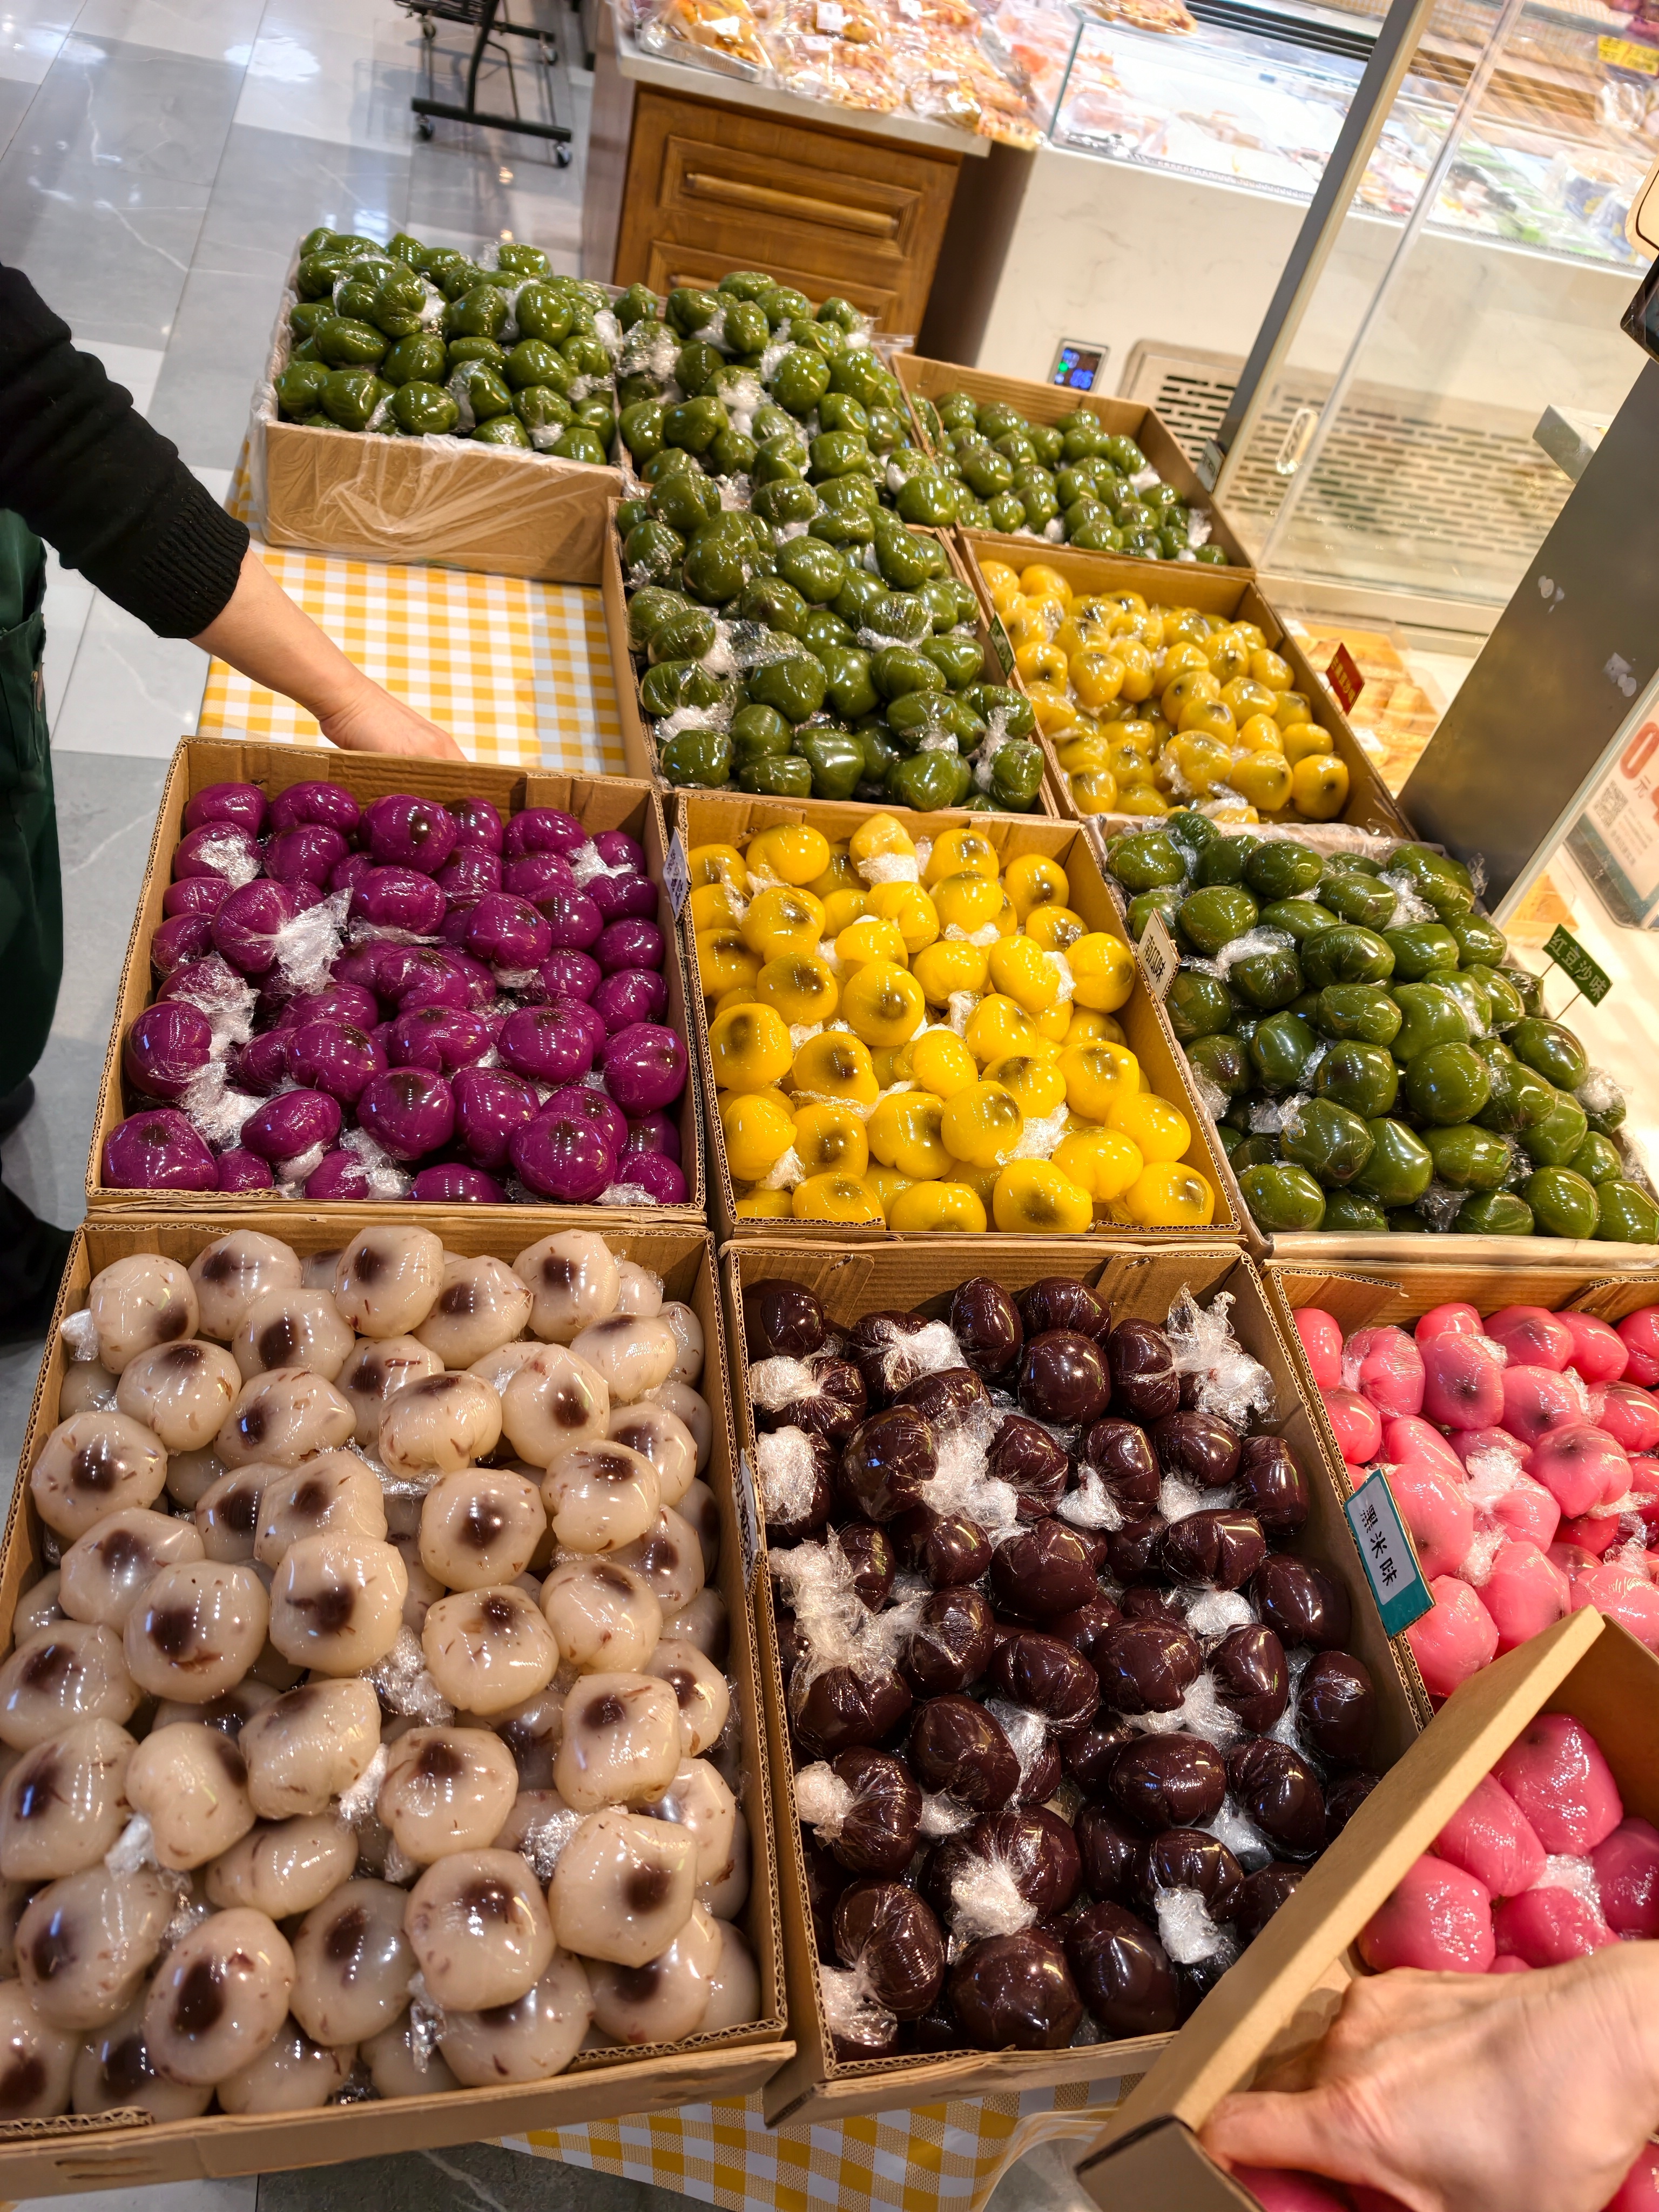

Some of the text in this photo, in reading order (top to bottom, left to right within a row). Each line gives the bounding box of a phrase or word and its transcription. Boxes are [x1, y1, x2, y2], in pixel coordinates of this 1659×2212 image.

[1143, 933, 1166, 984] 南瓜味
[1548, 933, 1607, 999] 红豆沙味
[1359, 1503, 1398, 1586] 黑米味
